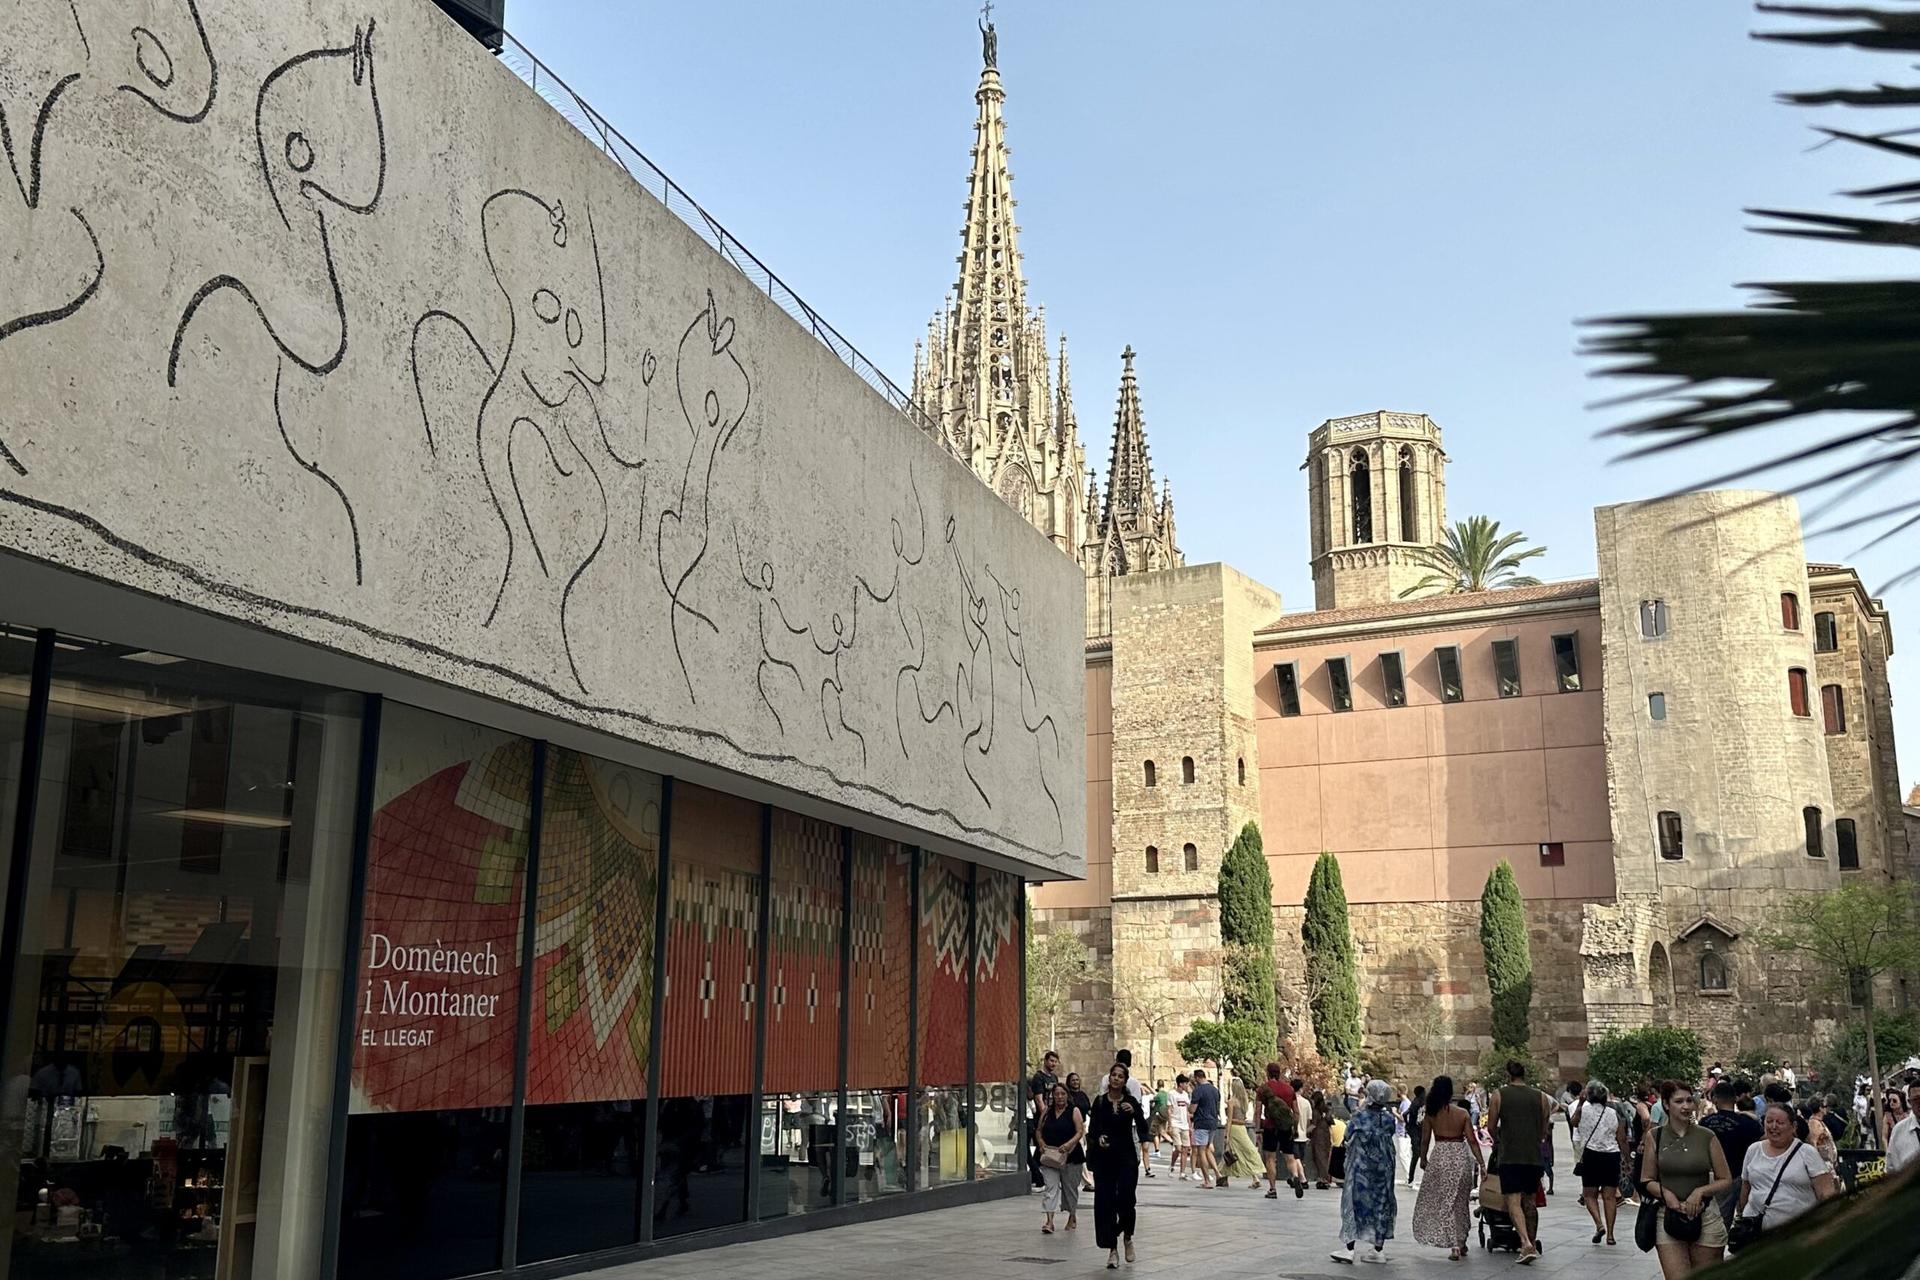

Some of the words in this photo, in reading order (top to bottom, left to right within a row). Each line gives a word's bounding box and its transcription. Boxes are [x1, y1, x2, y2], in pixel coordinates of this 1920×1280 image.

[368, 934, 498, 976] Domènech
[364, 979, 372, 1015] i
[380, 980, 499, 1017] Montaner
[361, 1029, 377, 1046] EL
[384, 1030, 434, 1046] LLEGAT
